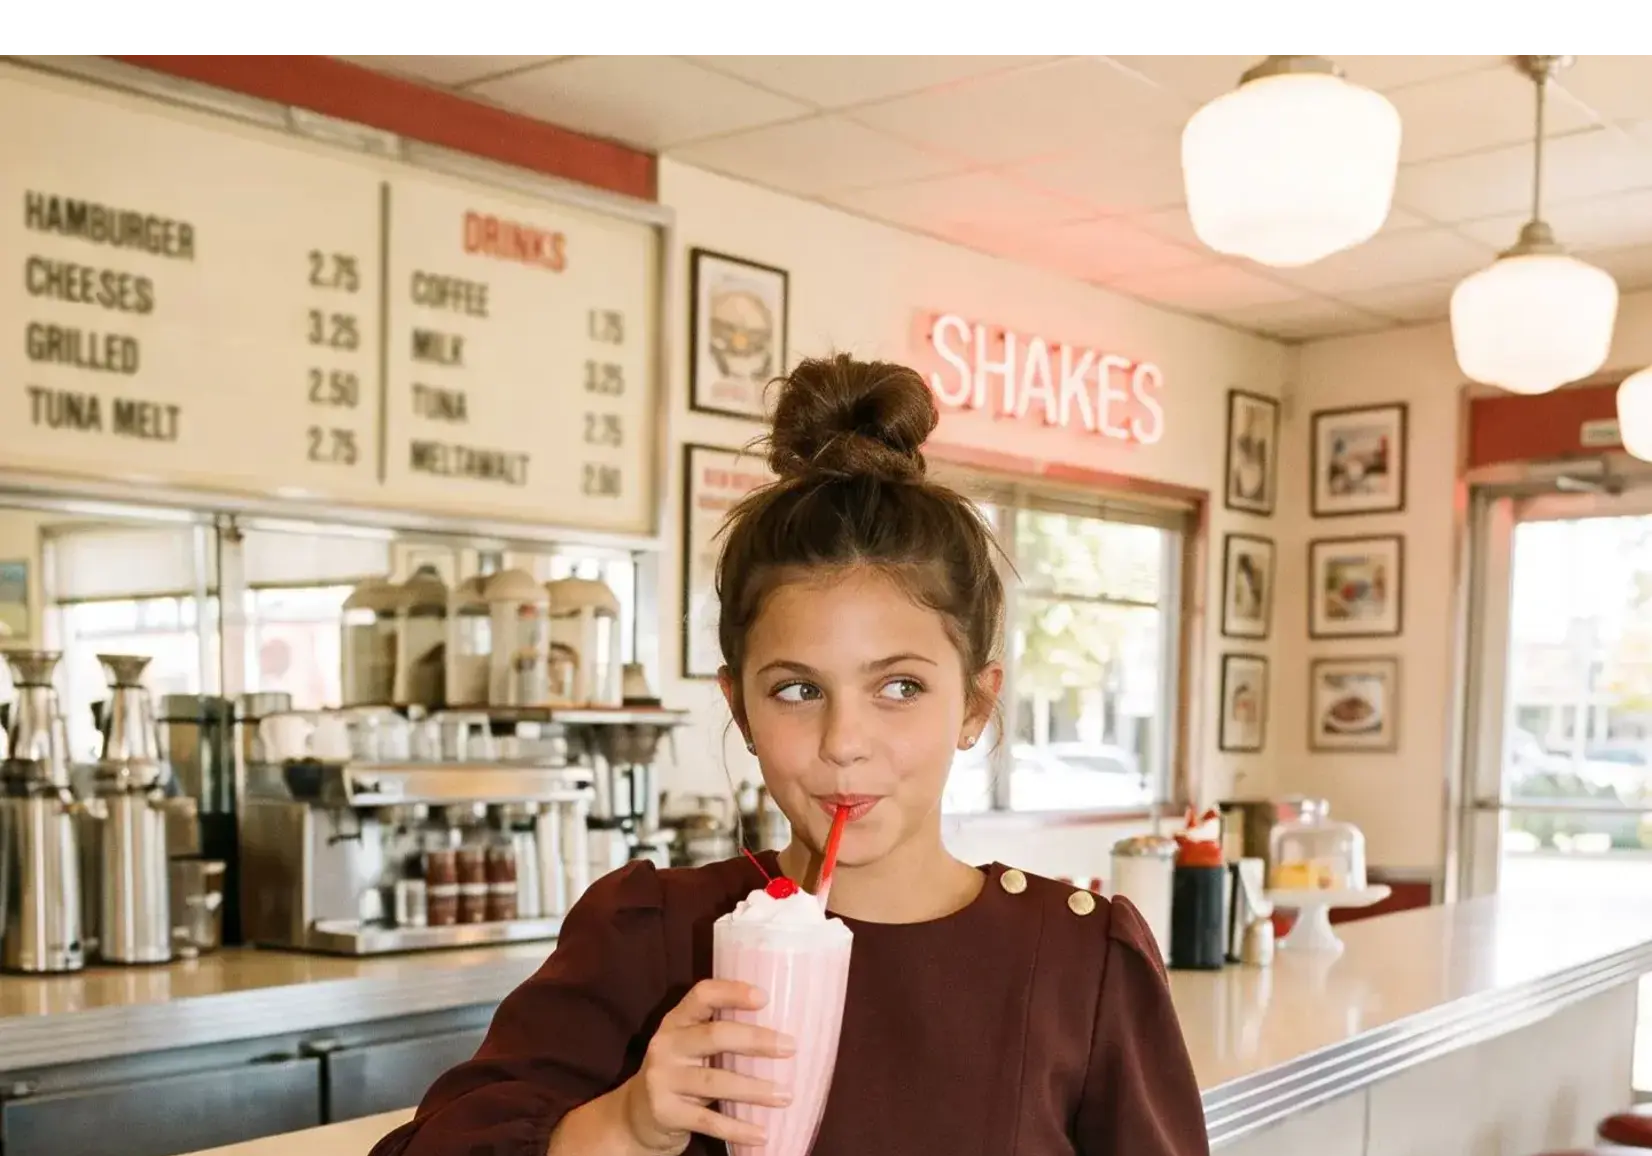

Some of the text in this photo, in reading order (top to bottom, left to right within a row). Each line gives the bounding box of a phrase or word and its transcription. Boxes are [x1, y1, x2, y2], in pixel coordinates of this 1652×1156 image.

[25, 190, 360, 294] HAMBURGER 2.75
[463, 209, 567, 275] DRINKS
[25, 255, 360, 352] CHEESES 3.25
[411, 270, 489, 317] COFFEE
[25, 321, 360, 408] GRILLED 2.50
[931, 313, 1164, 444] SHAKES
[25, 384, 358, 466] TUNA MELT 2.75
